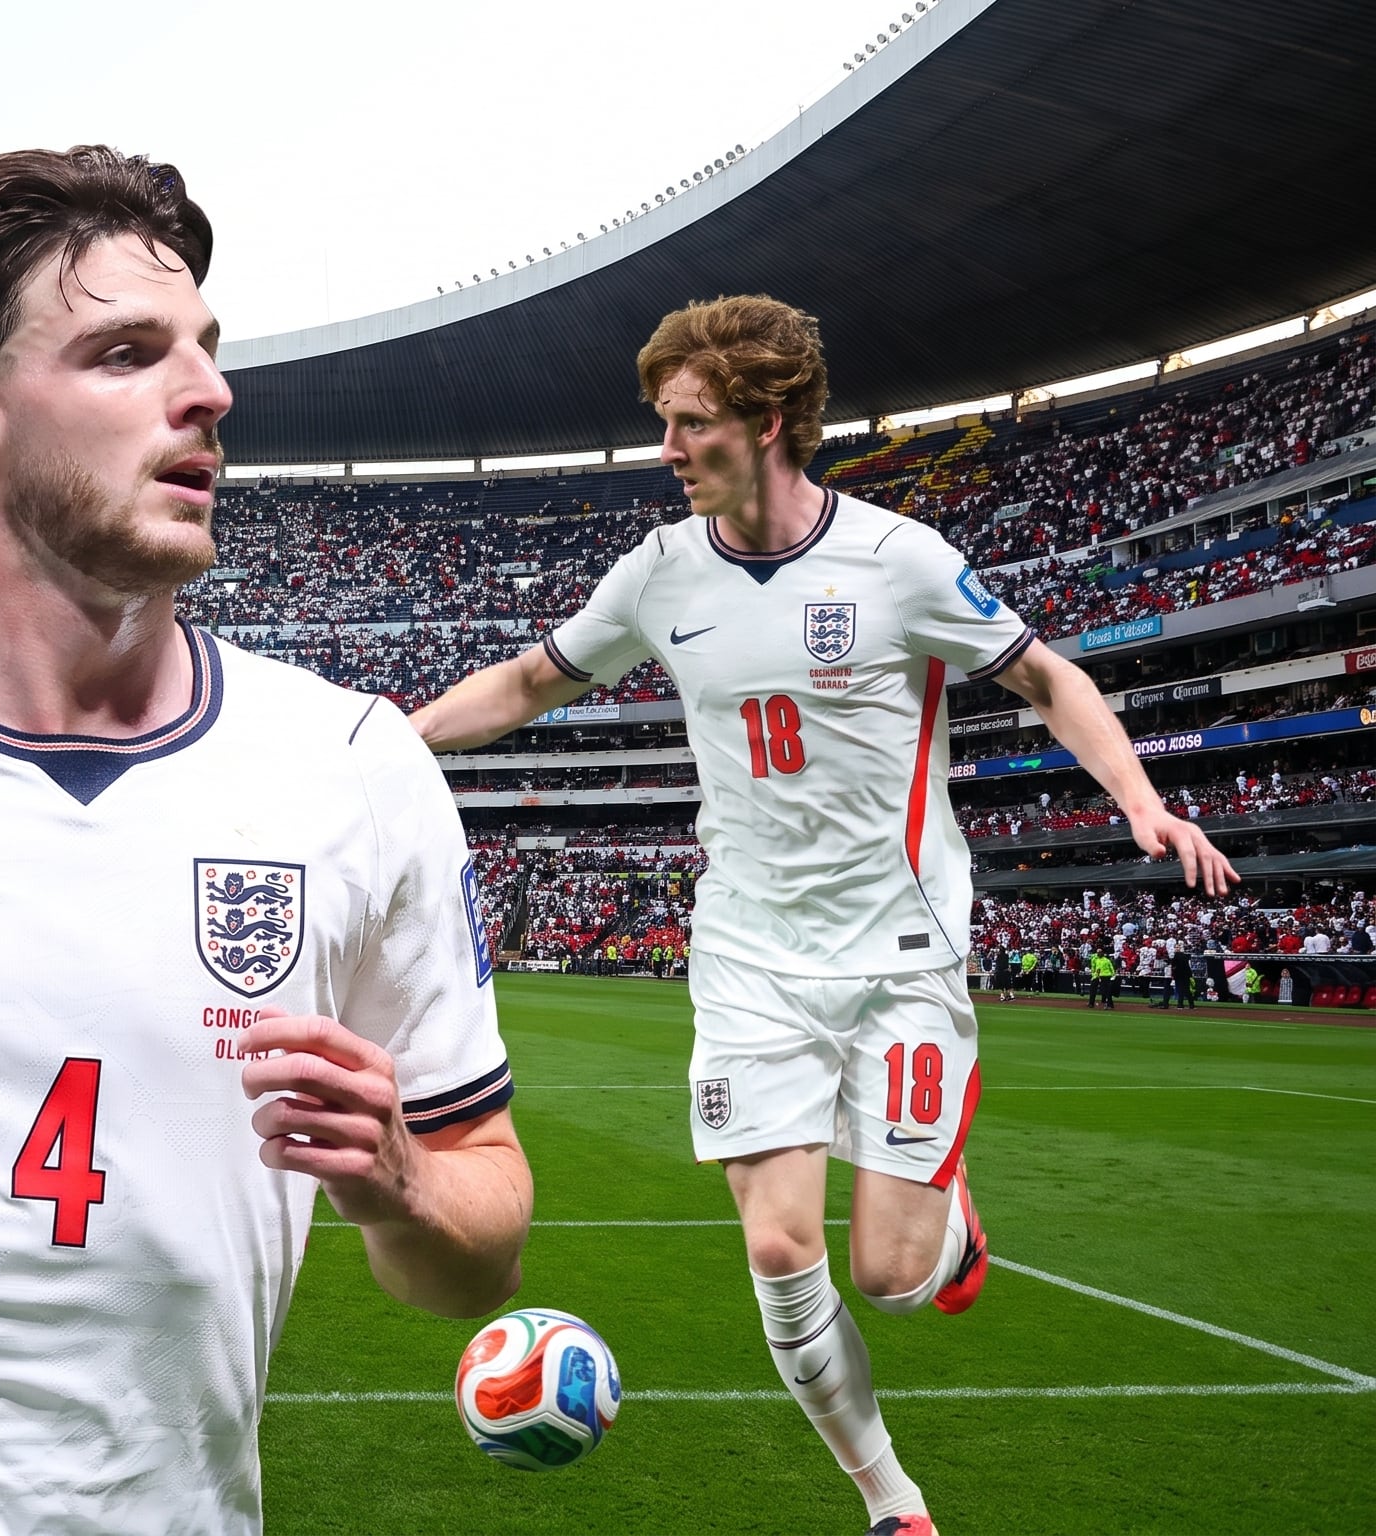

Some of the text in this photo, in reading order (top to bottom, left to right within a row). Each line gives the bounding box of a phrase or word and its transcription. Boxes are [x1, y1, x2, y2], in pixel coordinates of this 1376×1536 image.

[739, 694, 806, 779] 18
[884, 1042, 943, 1125] 18
[11, 1056, 106, 1249] 4
